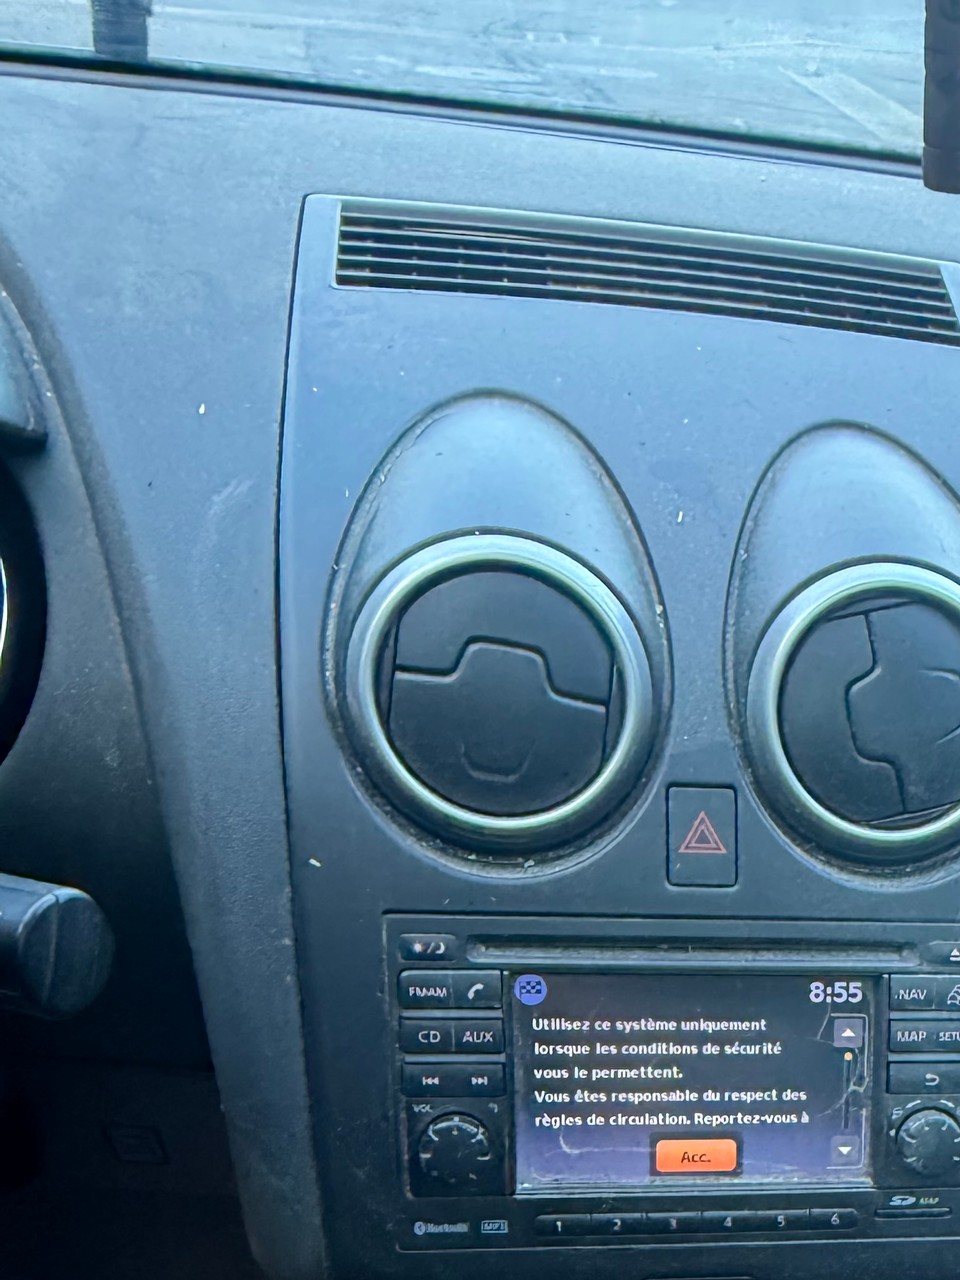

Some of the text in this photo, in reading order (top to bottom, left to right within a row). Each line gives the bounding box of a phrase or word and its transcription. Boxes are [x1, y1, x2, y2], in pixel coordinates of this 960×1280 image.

[809, 981, 863, 1003] 8:55
[899, 989, 927, 1001] NAV
[532, 1017, 767, 1033] Utilisez ce système uniquement
[418, 1030, 441, 1044] CD
[462, 1030, 493, 1043] AUX
[896, 1030, 926, 1042] MAP
[534, 1041, 782, 1057] lorsque les conditions de sécurité
[533, 1066, 683, 1081] vous le permettent.
[534, 1088, 807, 1104] Vous êtes responsable du respect des
[534, 1112, 582, 1128] règles
[586, 1112, 605, 1126] de
[609, 1112, 691, 1126] circulation.
[694, 1111, 798, 1127] Reportez-vous
[680, 1151, 712, 1164] Acc.
[555, 1220, 563, 1232] 1
[612, 1218, 622, 1231] 2
[723, 1215, 733, 1228] 4
[776, 1214, 786, 1227] 5
[830, 1212, 841, 1226] 6
